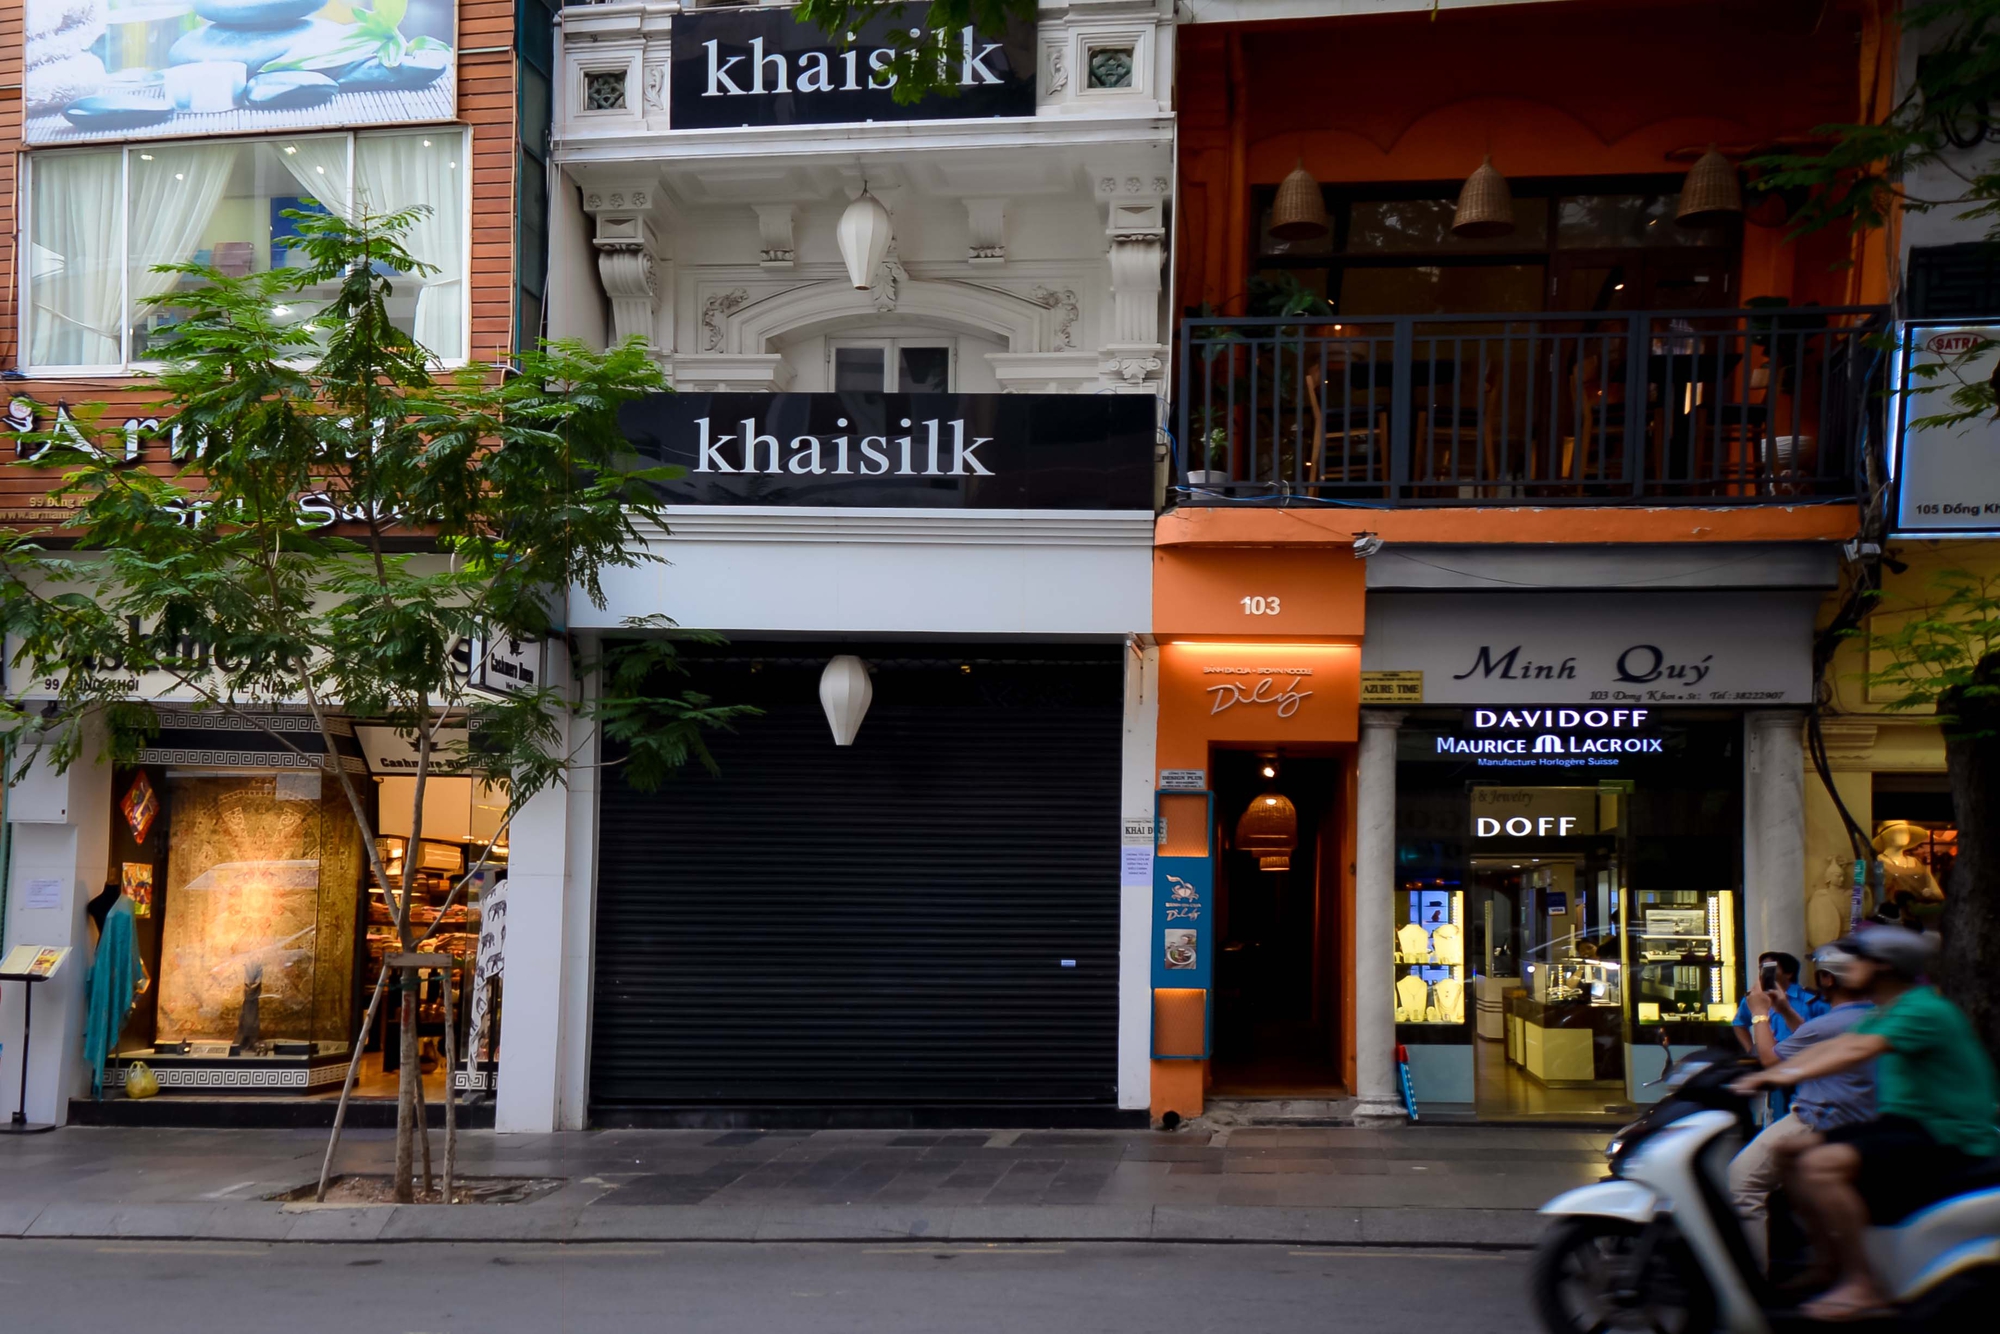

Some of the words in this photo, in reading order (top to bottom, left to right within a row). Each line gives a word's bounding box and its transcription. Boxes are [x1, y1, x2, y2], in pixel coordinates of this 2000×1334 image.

[692, 417, 996, 476] khaisilk
[29, 497, 44, 507] 99
[1916, 504, 1939, 515] 105
[1240, 596, 1281, 615] 103
[1453, 645, 1577, 680] Minh
[1613, 645, 1714, 687] Quý
[44, 678, 60, 690] 99
[1363, 684, 1394, 694] AZURE
[1396, 684, 1420, 694] TIME
[1589, 690, 1608, 700] 103
[1475, 709, 1648, 728] DAVIDOFF
[1437, 737, 1527, 754] MAURICE
[1570, 736, 1663, 753] LACROIX
[1478, 758, 1537, 767] Manufacture
[1539, 757, 1586, 768] Horlogère
[1588, 757, 1619, 766] Suisse
[1477, 817, 1577, 837] DOFF
